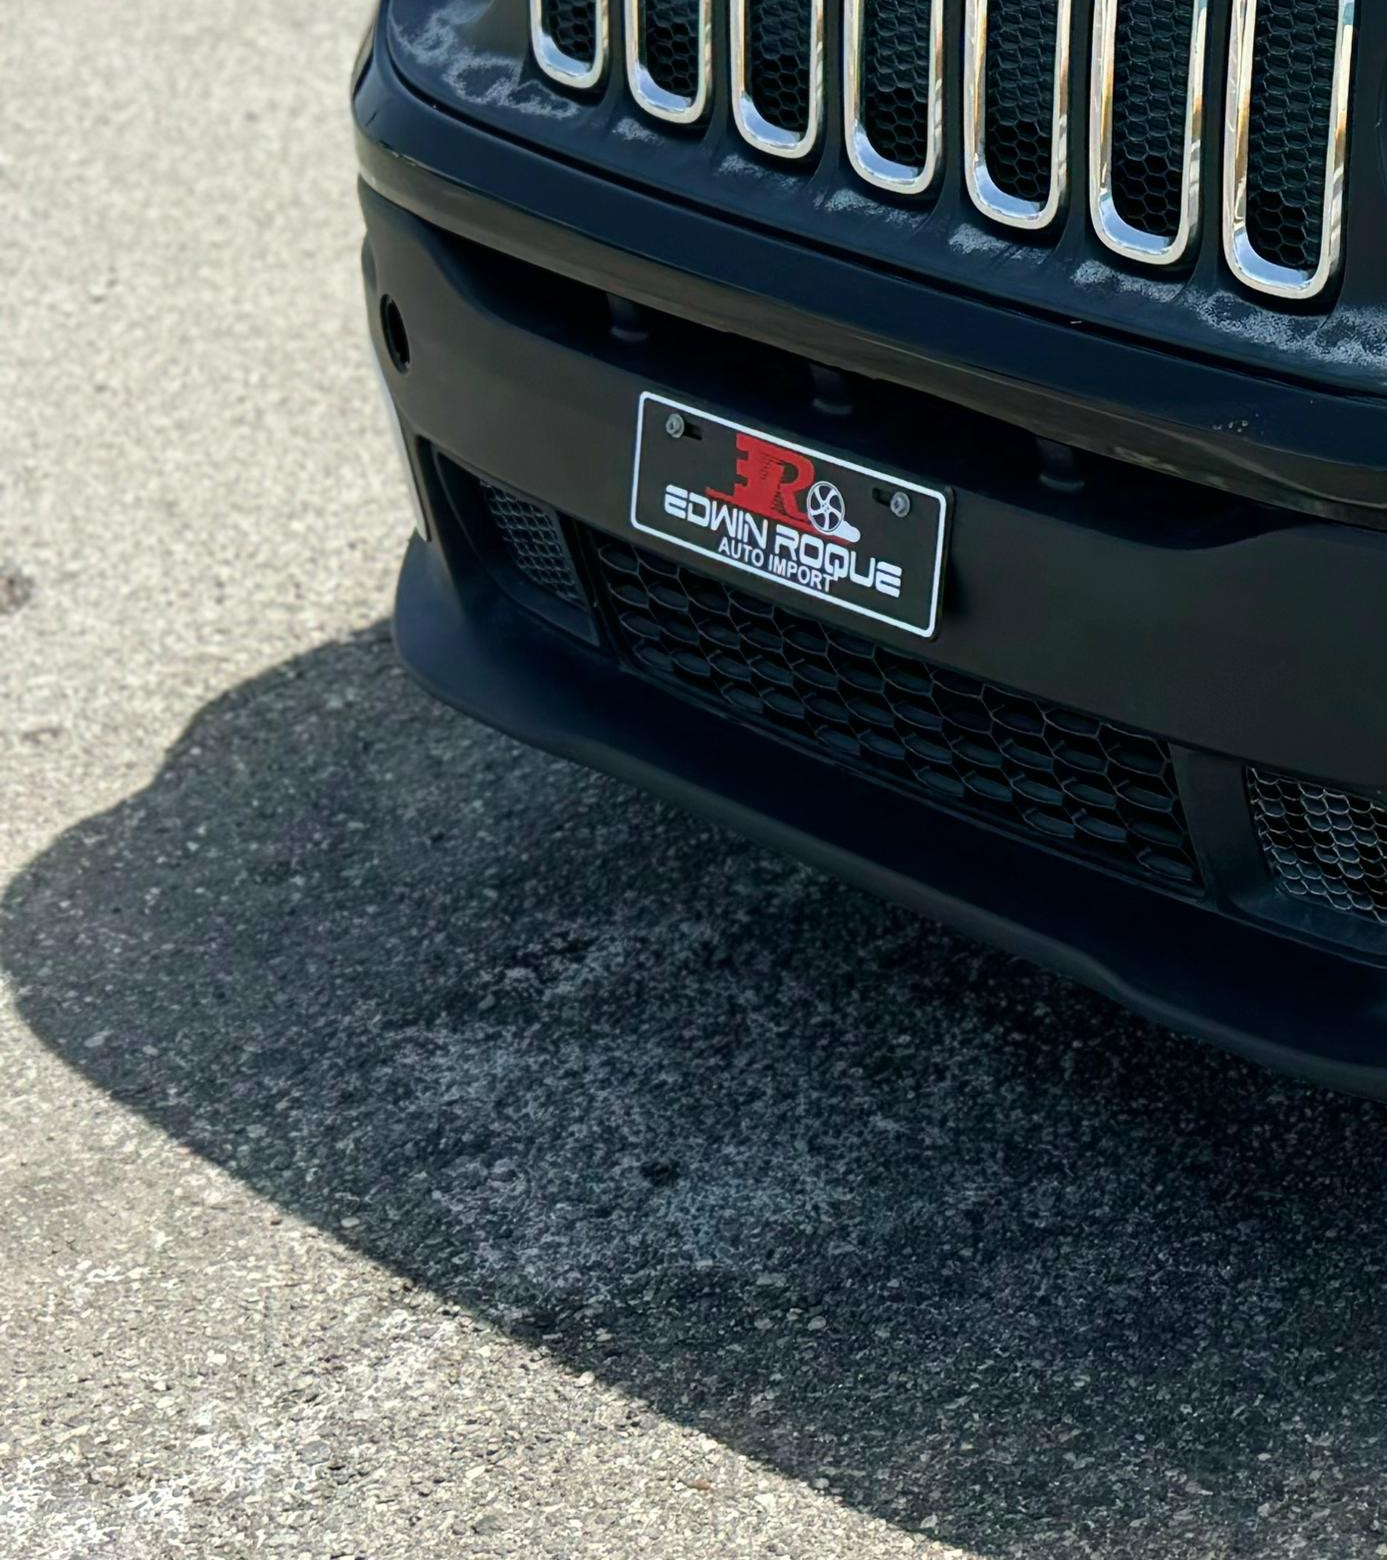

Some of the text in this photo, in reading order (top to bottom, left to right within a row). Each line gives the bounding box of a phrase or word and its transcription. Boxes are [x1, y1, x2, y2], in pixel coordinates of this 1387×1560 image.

[664, 484, 903, 599] EDWIN ROQUE
[718, 535, 835, 593] AUTO IMPORT
